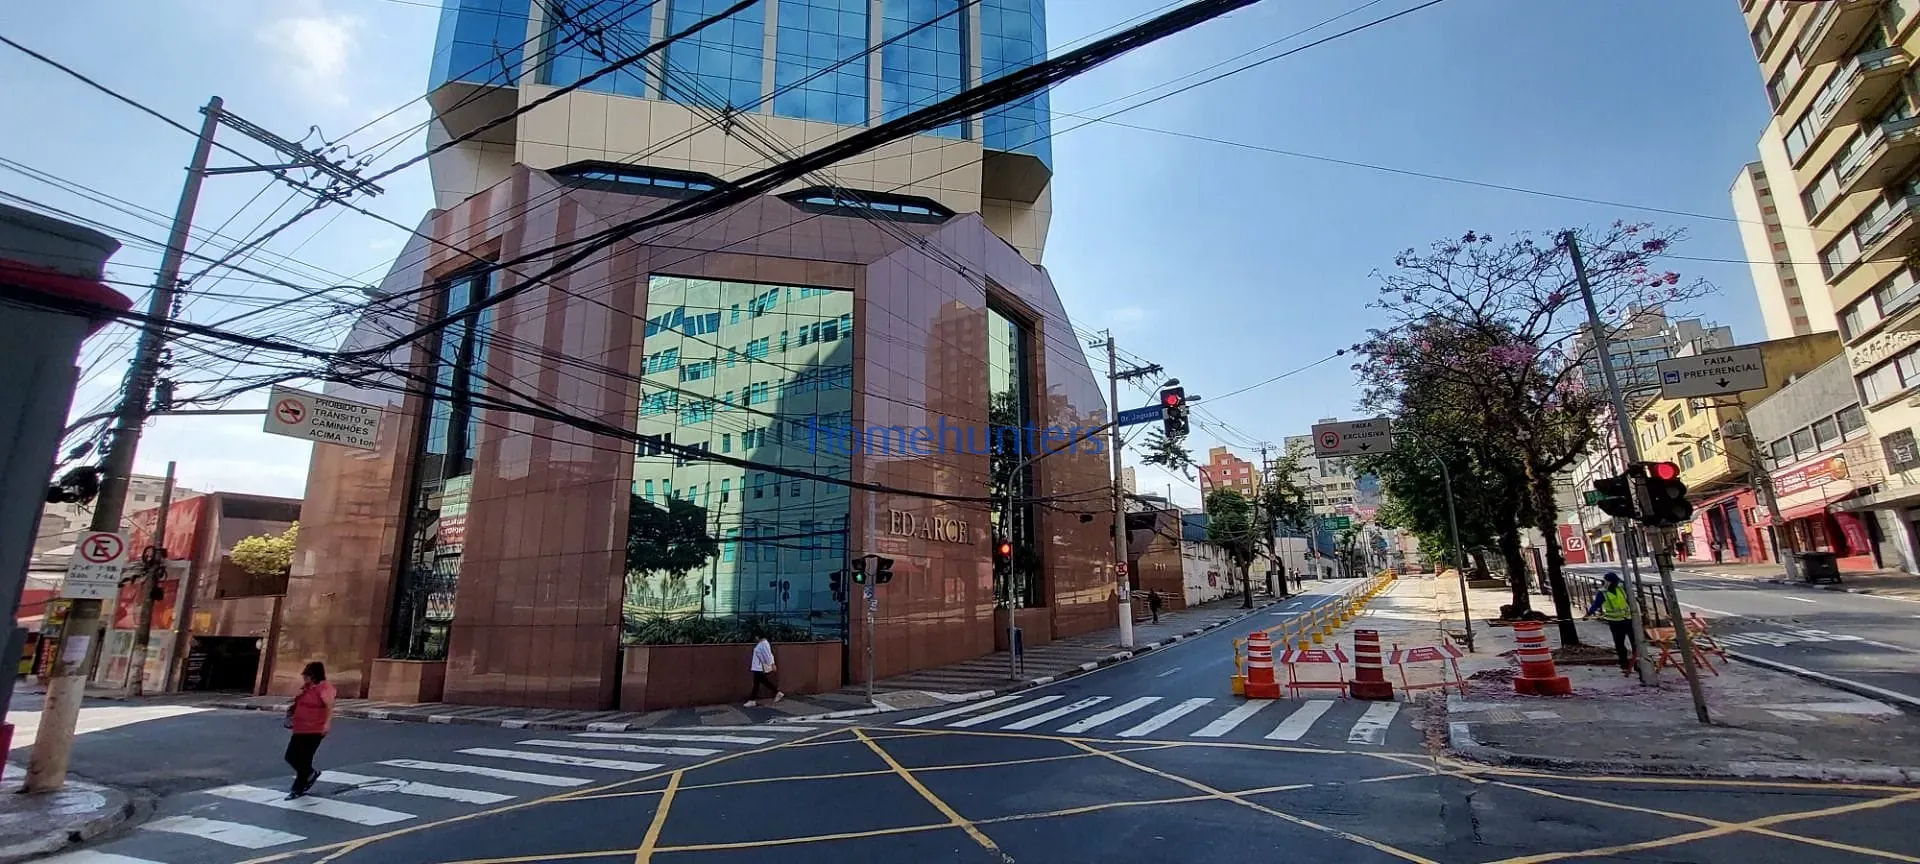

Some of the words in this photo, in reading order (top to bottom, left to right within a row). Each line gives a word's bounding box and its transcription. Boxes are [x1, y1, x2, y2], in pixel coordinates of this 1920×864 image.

[1704, 356, 1733, 366] FAIXA
[1683, 364, 1759, 379] PREFERENCIAL
[315, 398, 357, 412] PROIBIDO
[364, 418, 376, 427] DE
[309, 429, 341, 441] ACIMA
[345, 436, 357, 444] 10
[360, 438, 374, 447] ton
[1343, 430, 1384, 440] EXCLUSIVA
[888, 508, 917, 537] ED.
